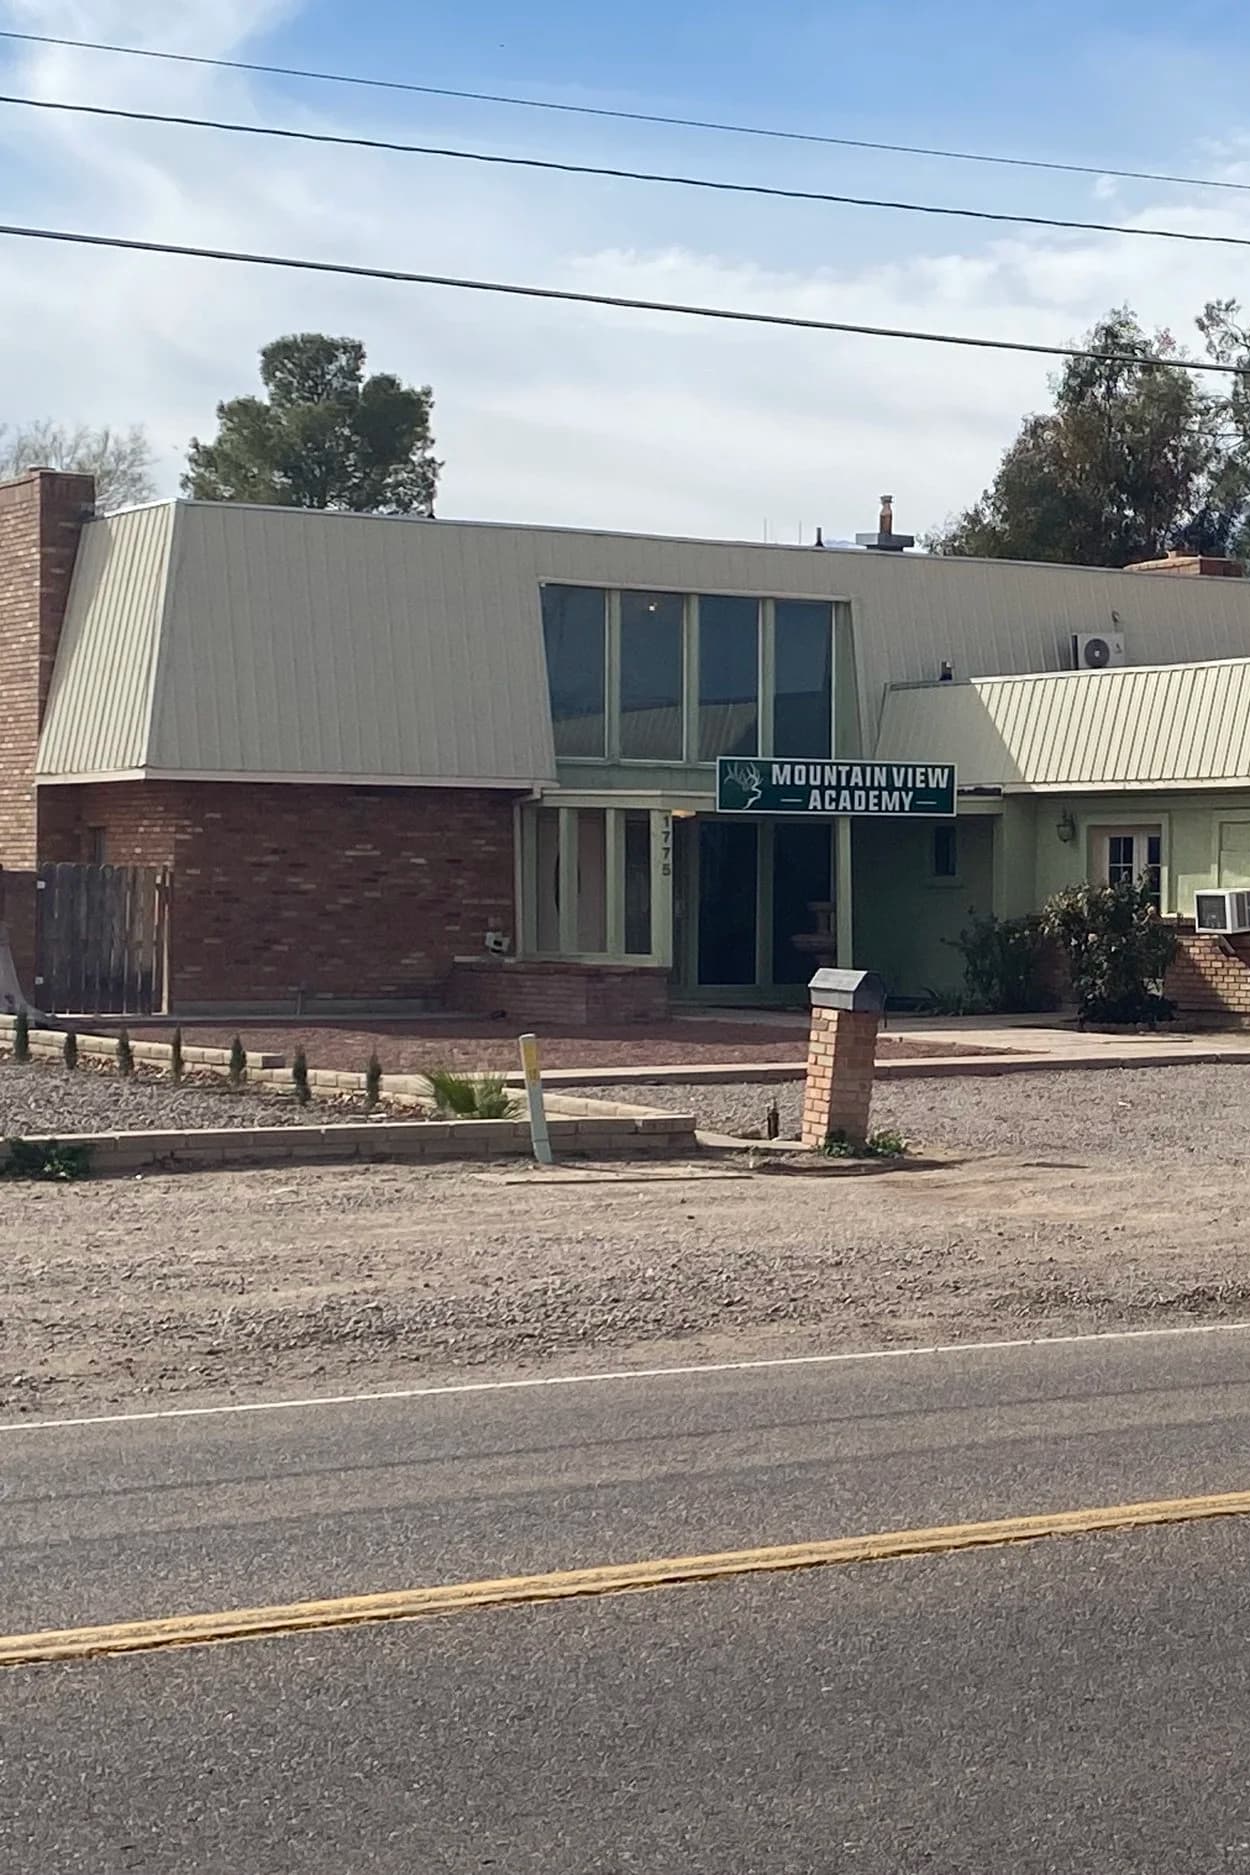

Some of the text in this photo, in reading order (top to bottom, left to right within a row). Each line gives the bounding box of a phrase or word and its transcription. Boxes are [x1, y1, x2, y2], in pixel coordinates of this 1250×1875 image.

[771, 763, 949, 789] MOUNTAIN VIEW
[808, 789, 914, 811] ACADEMY
[661, 815, 671, 876] 1775
